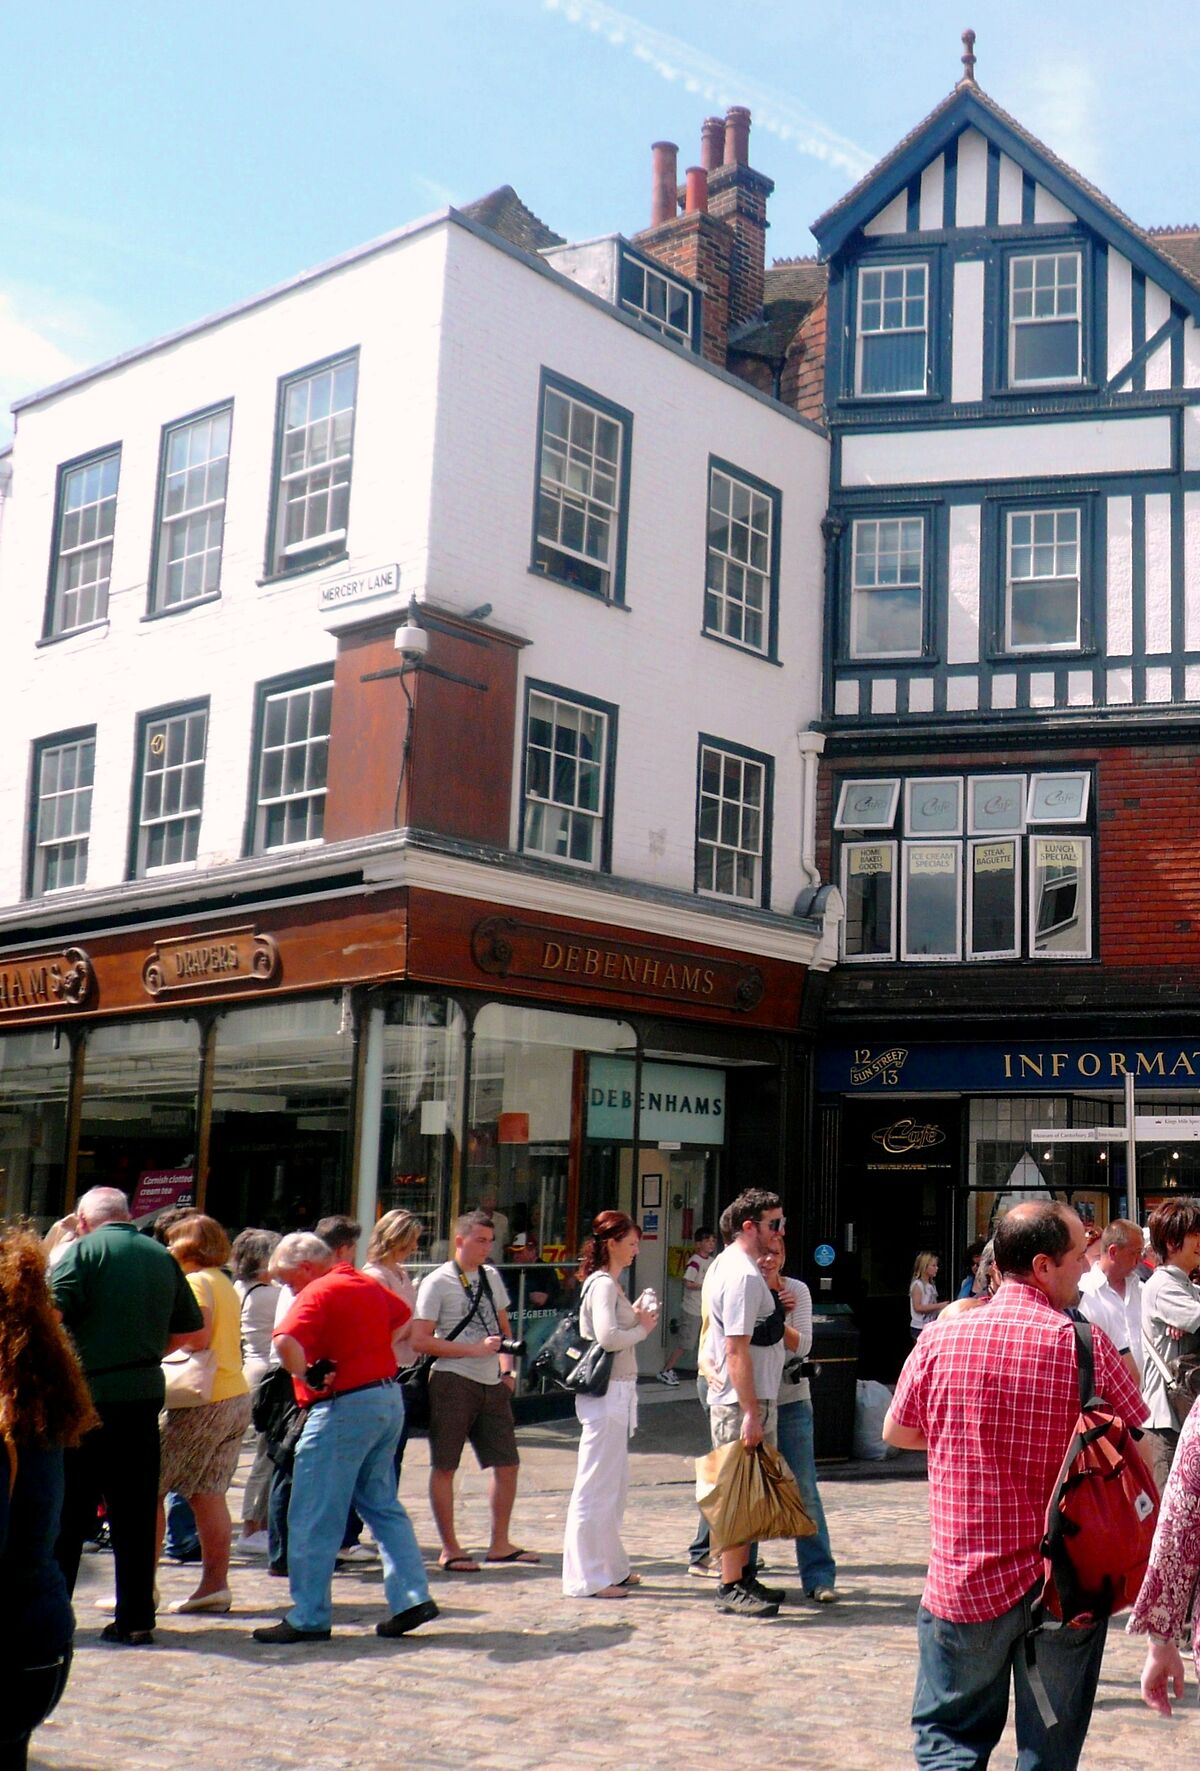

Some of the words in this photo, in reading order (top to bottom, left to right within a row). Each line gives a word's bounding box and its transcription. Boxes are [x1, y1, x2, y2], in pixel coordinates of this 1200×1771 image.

[322, 580, 364, 601] MERCERY
[367, 571, 393, 590] LANE
[983, 848, 1005, 856] STEAK
[1045, 845, 1074, 853] LUNCH
[926, 852, 953, 860] CREAM
[976, 855, 1011, 865] BAGUETTE
[916, 860, 950, 868] SPECIALS
[176, 943, 240, 978] DRAPERS
[542, 942, 715, 994] DEBENHAMS
[855, 1050, 871, 1064] 12
[853, 1067, 873, 1083] SUN
[872, 1051, 904, 1071] STREET
[882, 1070, 898, 1085] 13
[591, 1088, 722, 1116] DEBENHAMS
[143, 1176, 169, 1185] Cornish
[140, 1188, 160, 1196] cream
[161, 1187, 173, 1195] tea
